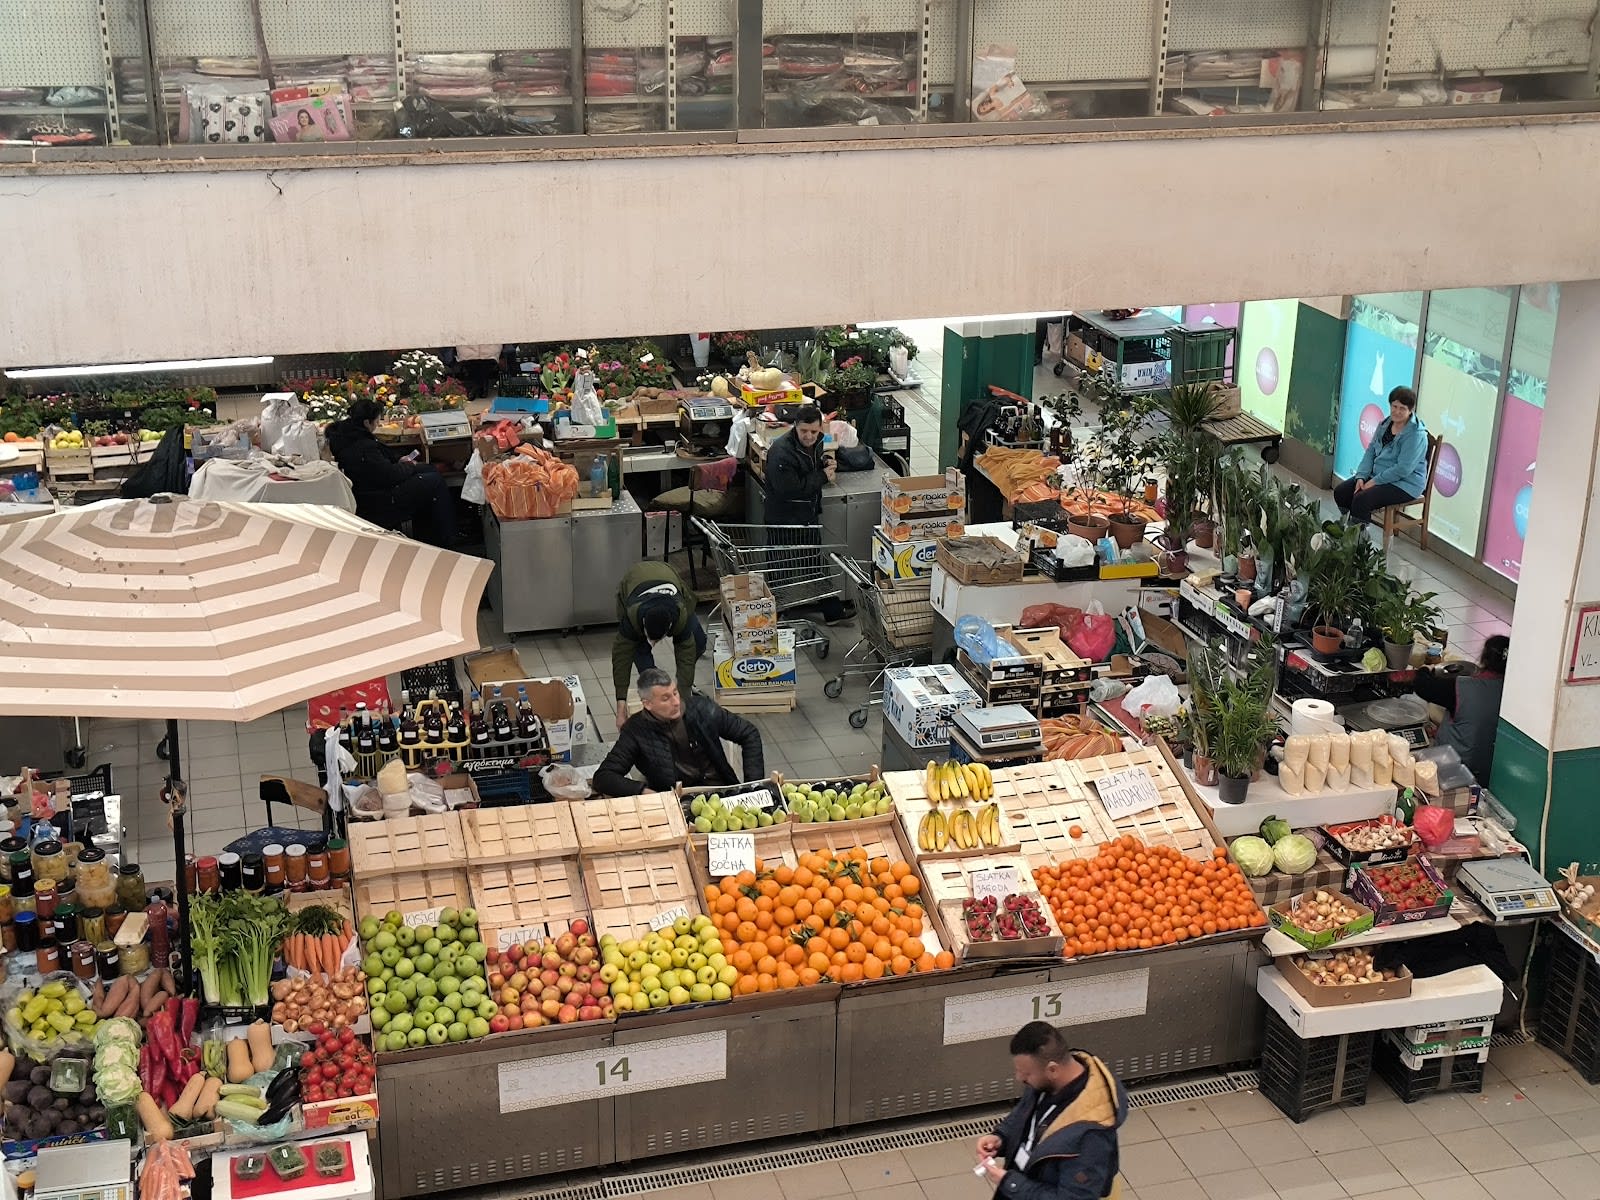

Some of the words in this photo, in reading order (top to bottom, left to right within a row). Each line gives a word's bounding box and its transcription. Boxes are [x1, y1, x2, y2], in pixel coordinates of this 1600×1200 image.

[739, 660, 773, 674] derby
[1098, 768, 1147, 791] SLATKA
[709, 837, 753, 850] SLATKA
[976, 872, 1011, 882] SLATKA
[976, 885, 1008, 894] JAGODA
[1031, 992, 1063, 1020] 13
[595, 1056, 632, 1086] 14
